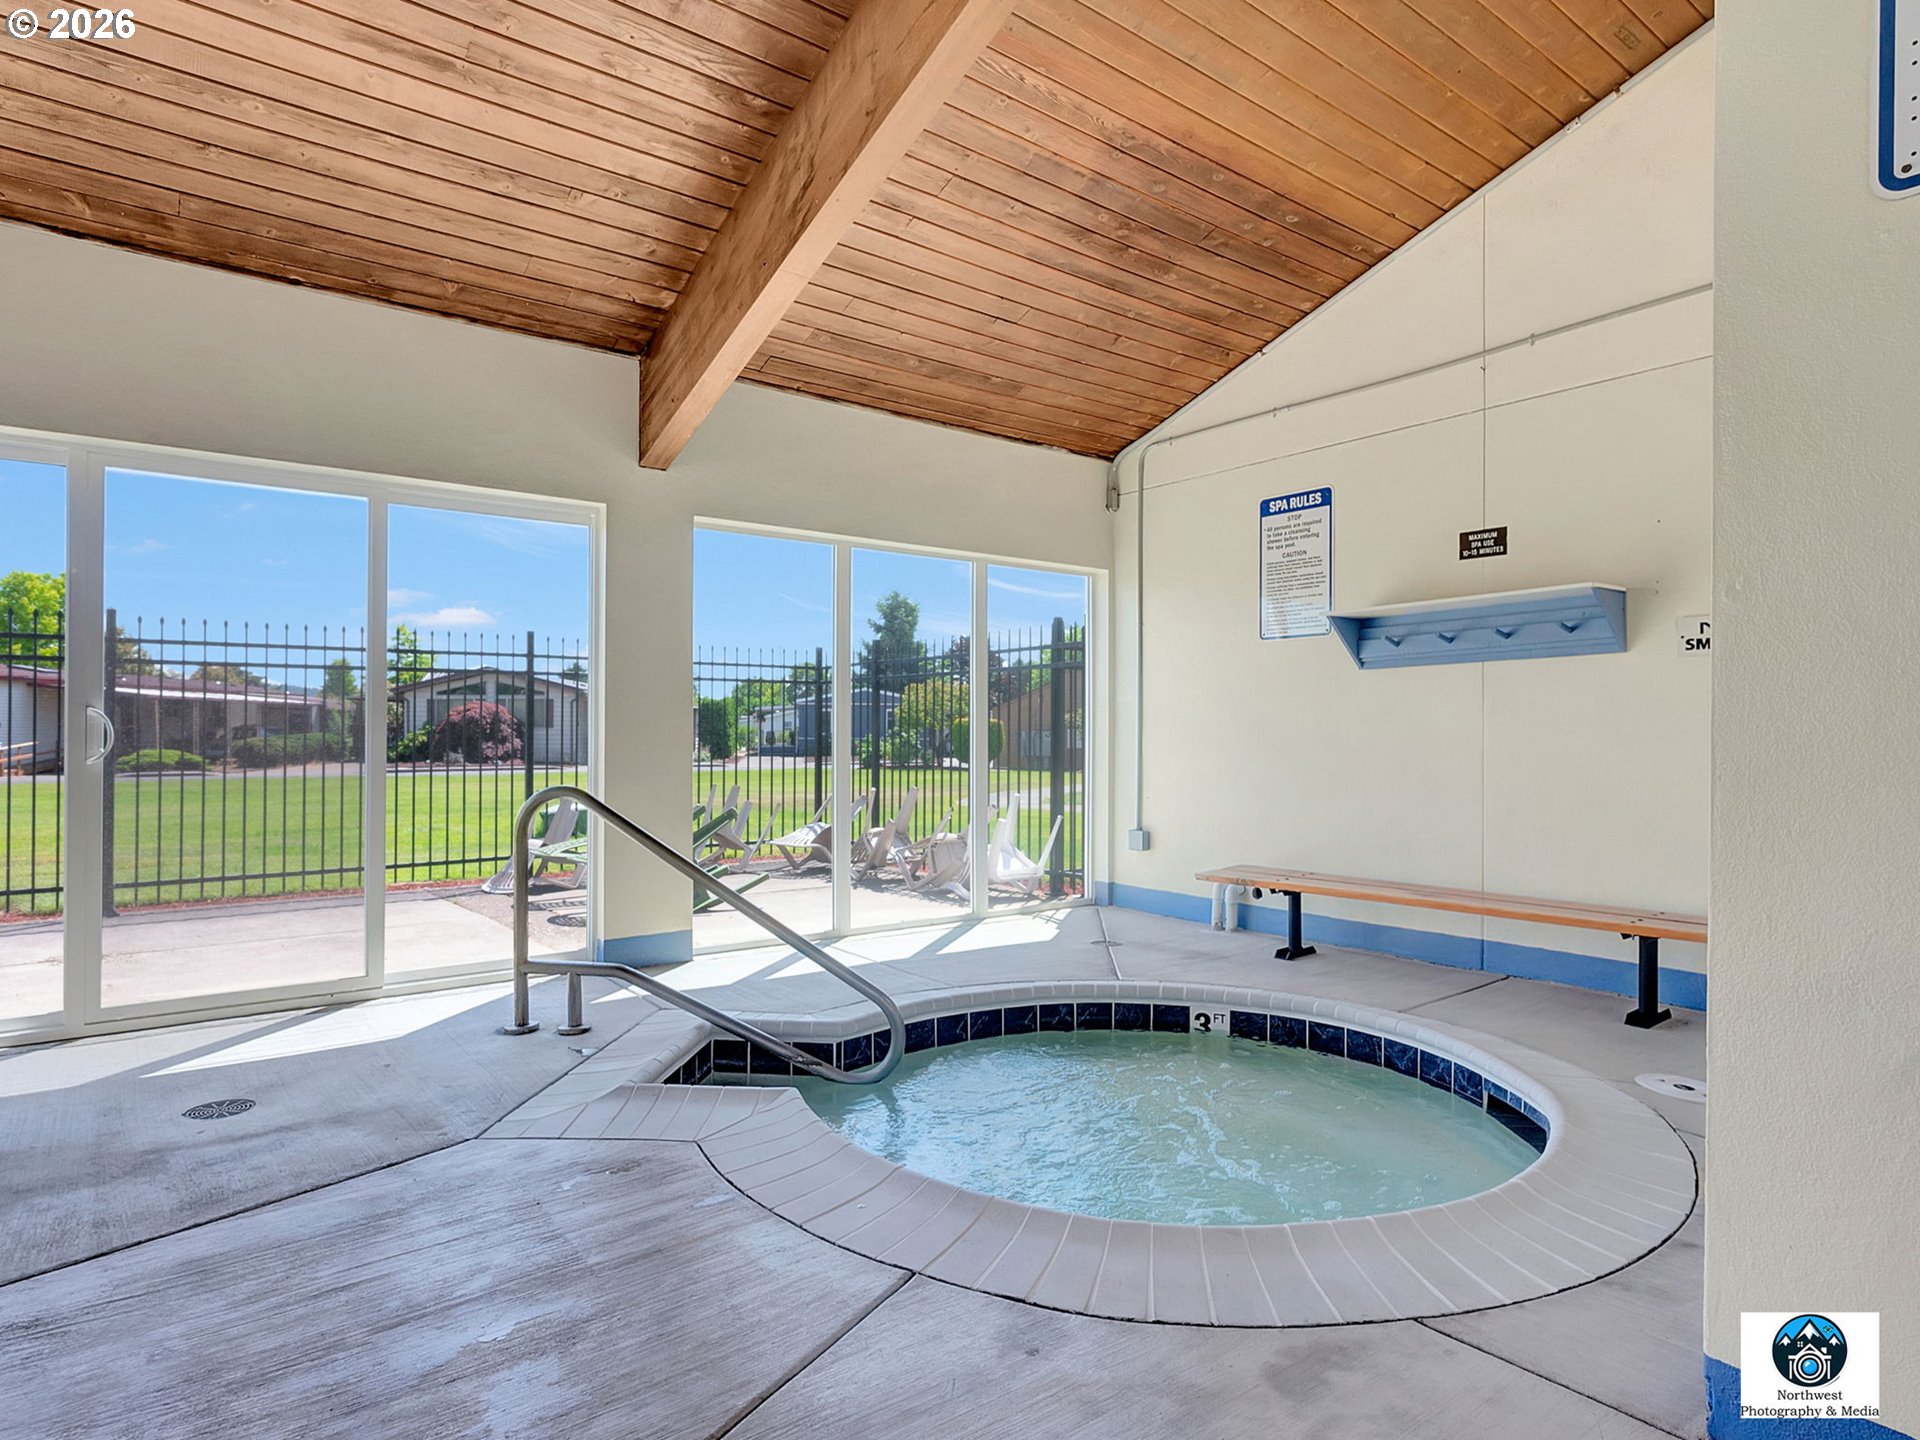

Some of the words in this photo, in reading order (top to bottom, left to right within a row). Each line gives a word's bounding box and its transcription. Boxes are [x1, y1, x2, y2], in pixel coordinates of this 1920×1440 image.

[1269, 499, 1288, 513] SPA
[1290, 492, 1322, 509] RULES
[1287, 513, 1302, 522] STOP
[1274, 524, 1292, 532] persons
[1302, 518, 1322, 526] required
[1288, 527, 1311, 535] cleansing
[1469, 531, 1498, 541] MAXIMUM
[1483, 539, 1495, 547] USE
[1479, 545, 1504, 554] MINUTES
[1282, 550, 1307, 559] CAUTION
[1194, 1012, 1212, 1033] 3
[1213, 1013, 1226, 1024] FT
